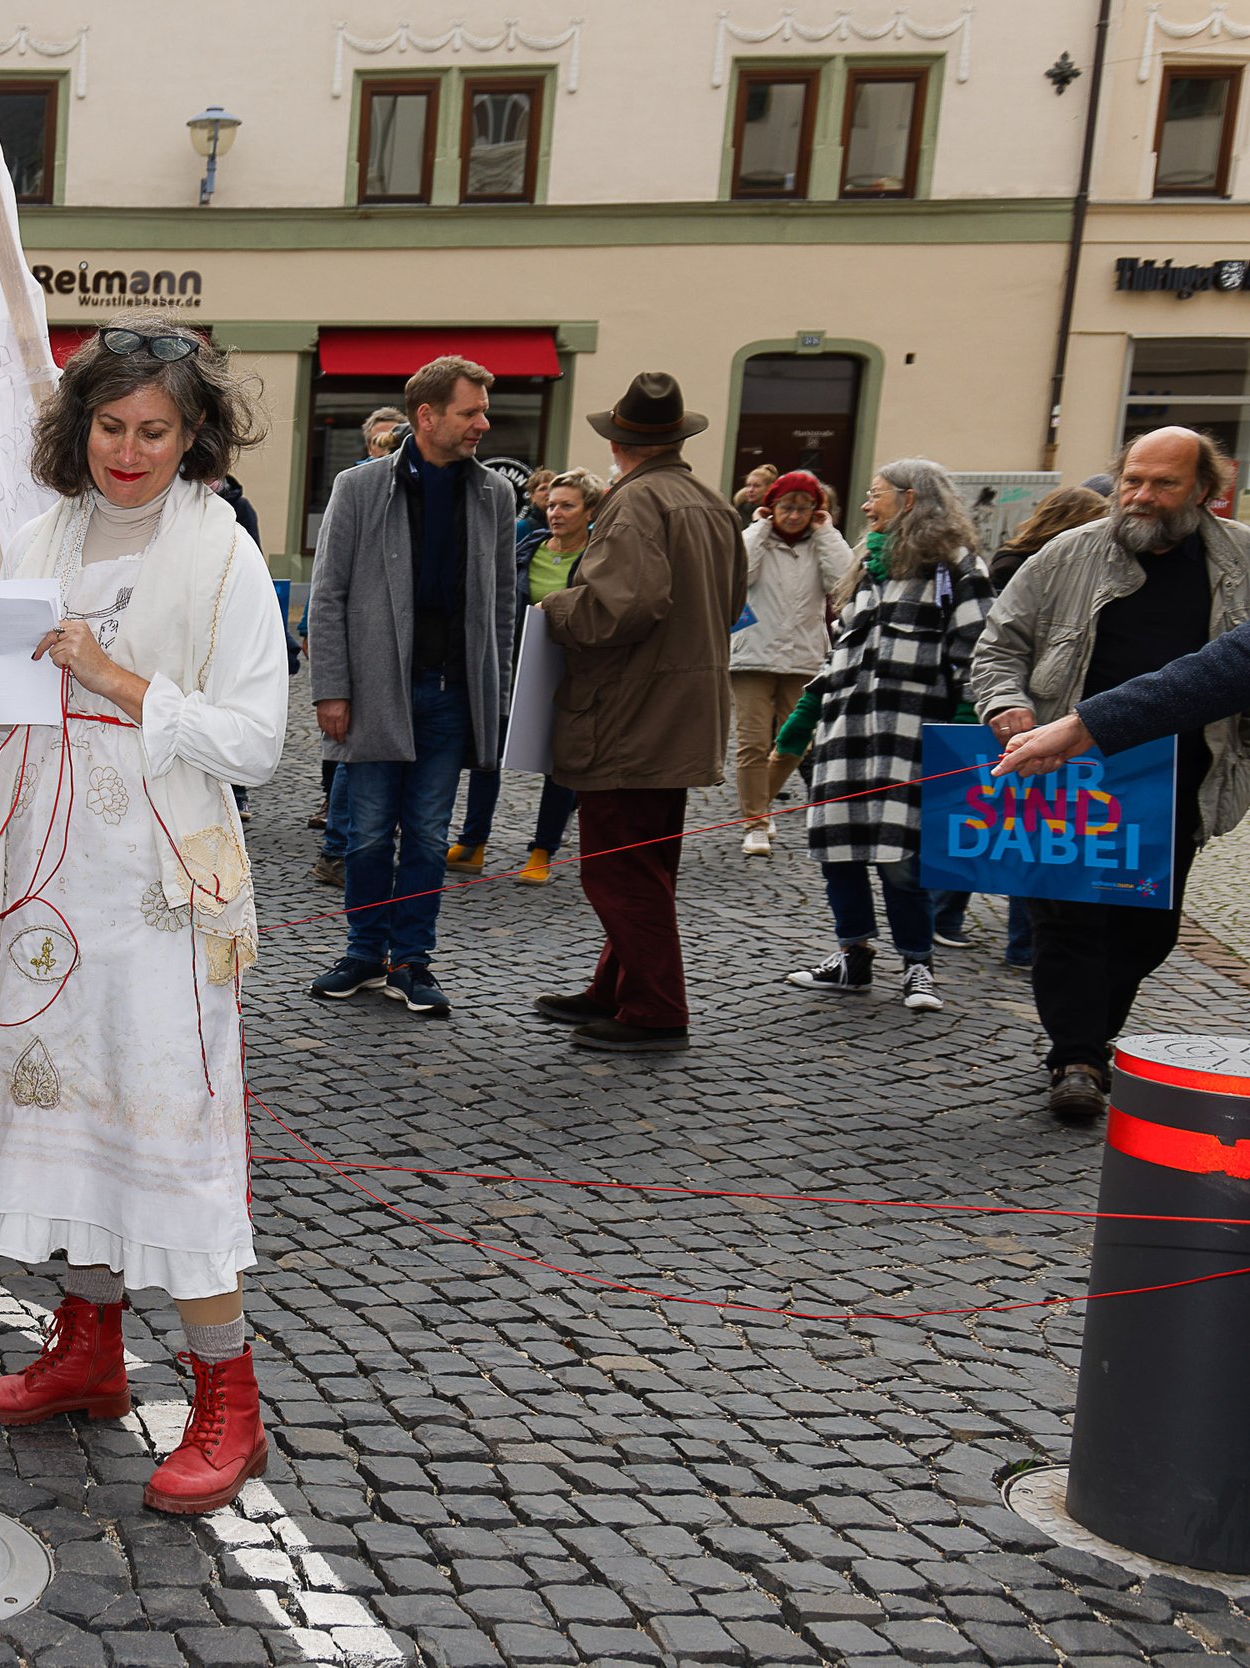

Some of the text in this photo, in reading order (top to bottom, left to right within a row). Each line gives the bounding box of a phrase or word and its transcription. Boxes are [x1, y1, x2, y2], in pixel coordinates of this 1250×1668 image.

[32, 261, 202, 295] Reimann
[965, 784, 1122, 836] SIND
[948, 813, 1141, 870] DABEI
